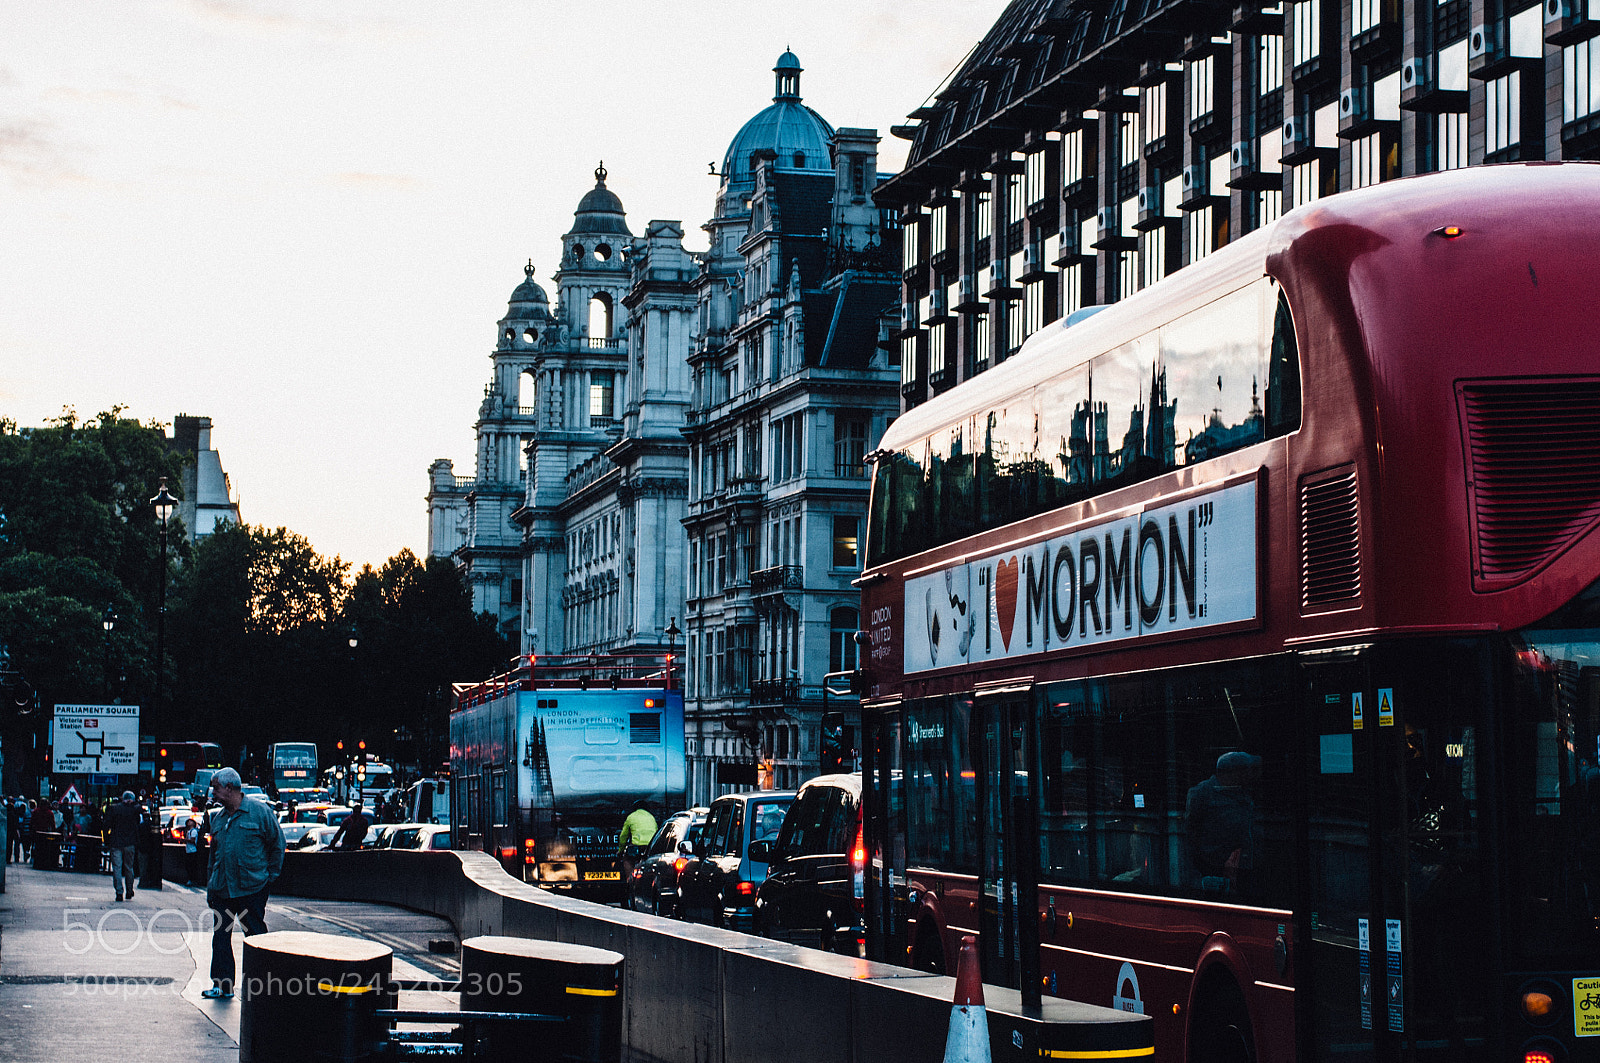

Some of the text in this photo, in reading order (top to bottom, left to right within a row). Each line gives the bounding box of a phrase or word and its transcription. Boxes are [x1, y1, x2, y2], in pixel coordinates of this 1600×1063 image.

[871, 606, 892, 626] LONDON
[871, 626, 892, 646] UNITED
[56, 706, 104, 714] PARLIAMENT
[568, 834, 619, 844] THE VIE
